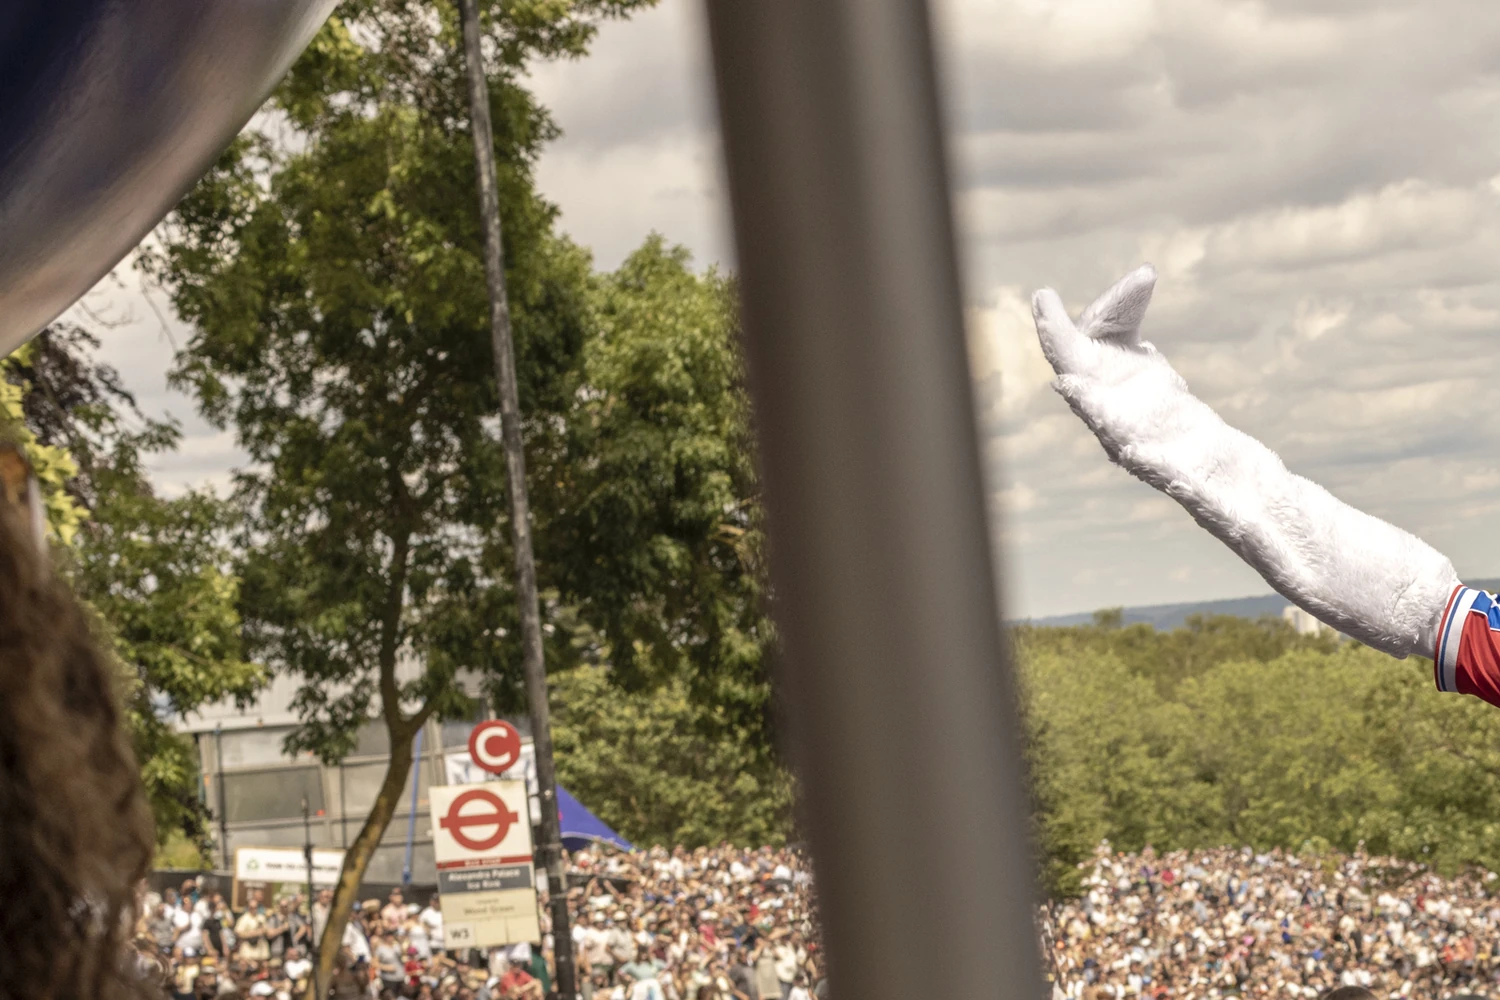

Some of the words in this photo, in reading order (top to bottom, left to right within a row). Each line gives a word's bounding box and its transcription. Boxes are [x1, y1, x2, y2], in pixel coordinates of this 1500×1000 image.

[475, 726, 511, 766] C
[448, 871, 490, 881] Alexandra
[492, 869, 520, 878] Palace
[450, 928, 469, 939] W3
